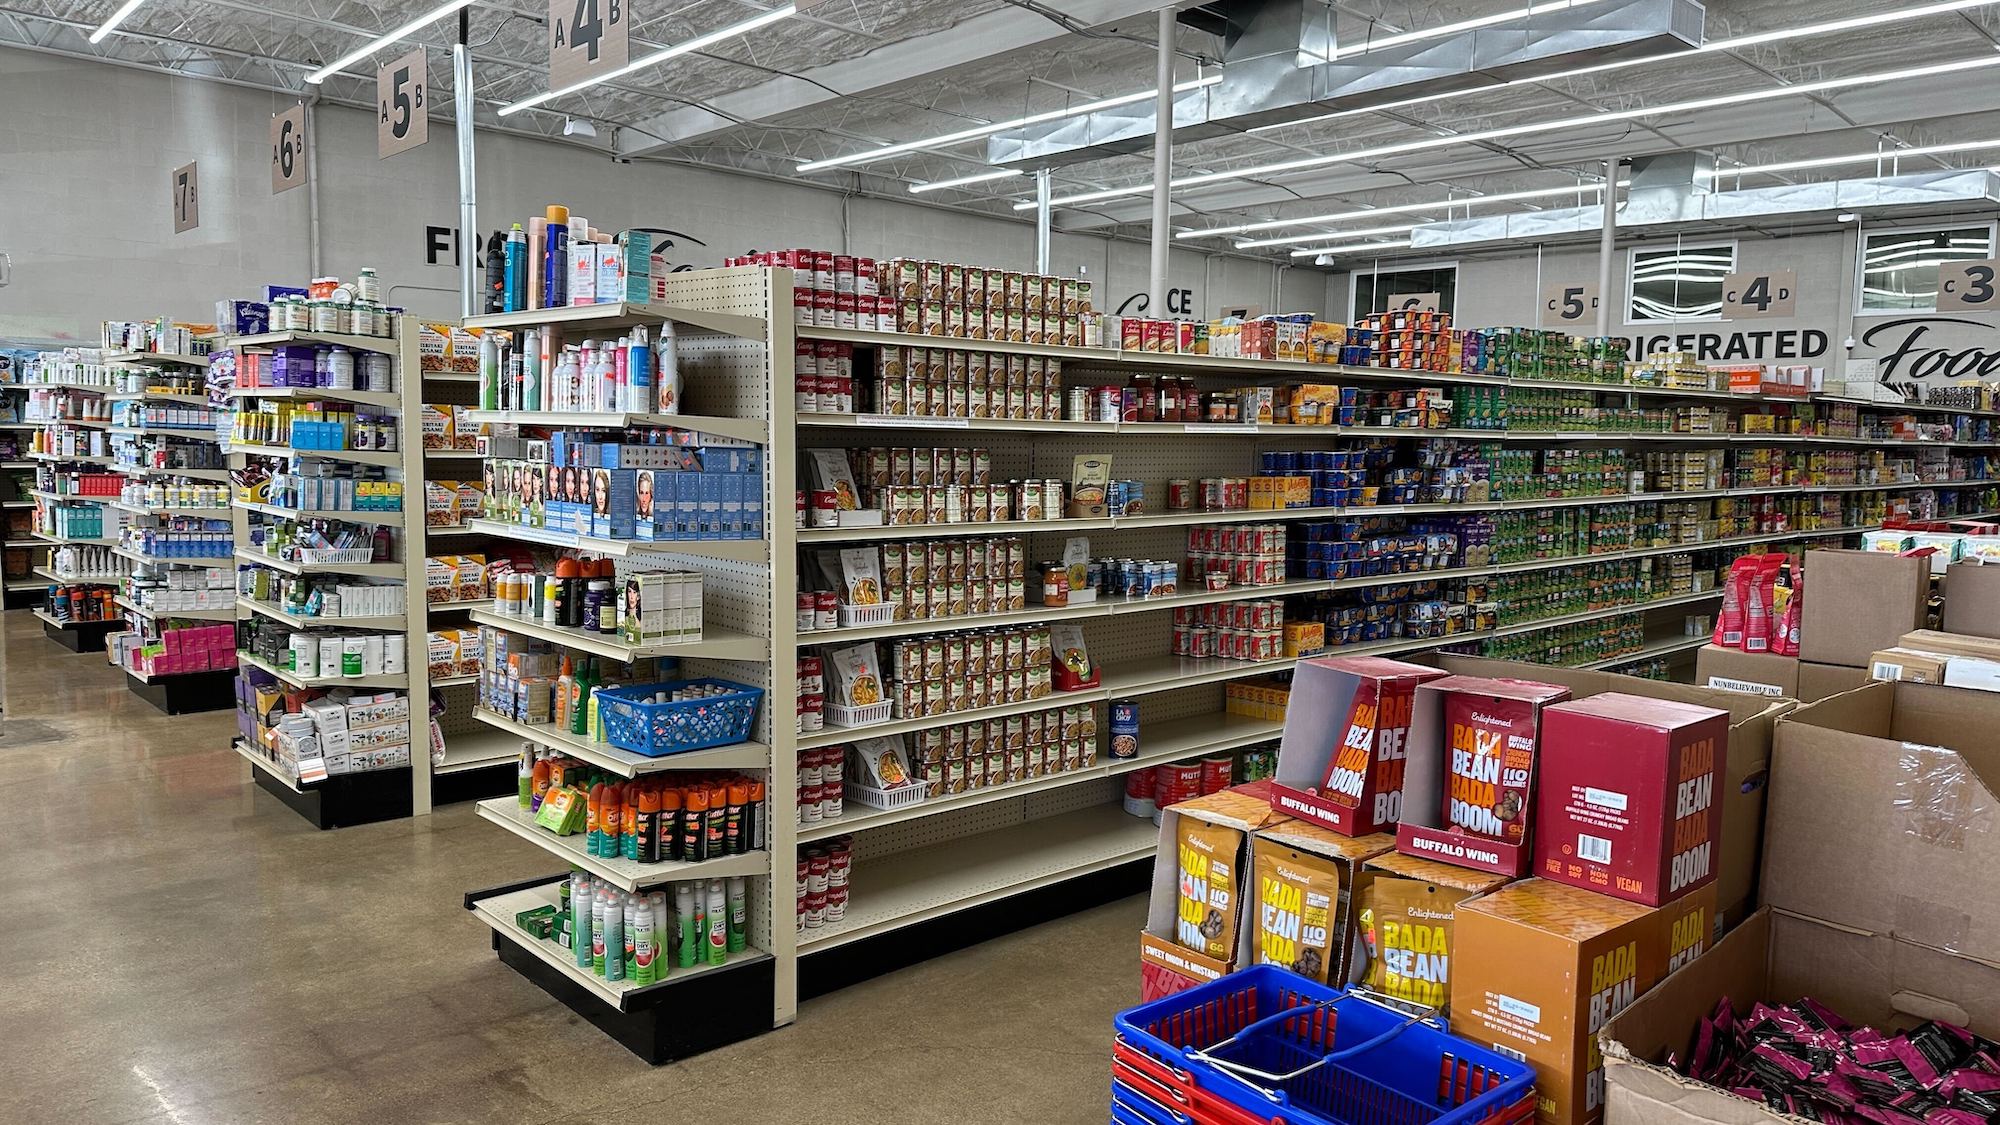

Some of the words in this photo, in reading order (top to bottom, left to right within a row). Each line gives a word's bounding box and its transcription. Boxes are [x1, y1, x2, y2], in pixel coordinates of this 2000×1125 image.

[555, 18, 565, 49] A
[570, 0, 603, 62] 4
[609, 0, 621, 26] B
[381, 100, 389, 124] A
[392, 66, 411, 139] 5
[415, 84, 423, 109] B
[273, 145, 279, 164] A
[280, 120, 294, 178] 6
[296, 134, 302, 154] B
[178, 172, 188, 222] 7
[1727, 291, 1736, 303] C
[1741, 276, 1772, 312] 4
[1779, 288, 1790, 300] D
[1944, 280, 1955, 293] C
[1960, 265, 1995, 304] 3
[1548, 299, 1556, 310] C
[1560, 287, 1584, 319] 5
[1768, 688, 1780, 696] INC
[1471, 711, 1513, 729] Enlightened
[1453, 723, 1502, 759] BADA
[1508, 741, 1532, 751] WING
[1452, 747, 1501, 786] BEAN
[1503, 768, 1528, 782] 110
[1680, 737, 1714, 782] BADA
[1451, 774, 1496, 809] BADA
[1675, 771, 1713, 821] BEAN
[1280, 795, 1317, 817] BUFFALO
[1315, 807, 1341, 825] WING
[1451, 799, 1503, 837] BOOM
[1674, 810, 1709, 855] BADA
[1412, 837, 1464, 857] BUFFALO
[1465, 847, 1499, 865] WING
[1546, 863, 1561, 874] FREE
[1568, 864, 1583, 873] NO
[1669, 840, 1712, 893] BOOM
[1568, 870, 1582, 879] SOY
[1589, 870, 1609, 880] NON
[1589, 876, 1608, 886] GMO
[1616, 876, 1643, 894] VEGAN
[1210, 888, 1229, 904] 110
[1407, 906, 1455, 921] Enlightened
[1303, 924, 1327, 941] 110
[1384, 920, 1448, 955] BADA
[1670, 907, 1705, 957] BADA
[1145, 945, 1166, 960] SWEET
[1184, 960, 1191, 970] &
[1190, 961, 1221, 980] MUSTARD
[1384, 948, 1448, 984] BEAN
[1591, 941, 1637, 995] BADA
[1385, 971, 1445, 1009] BADA
